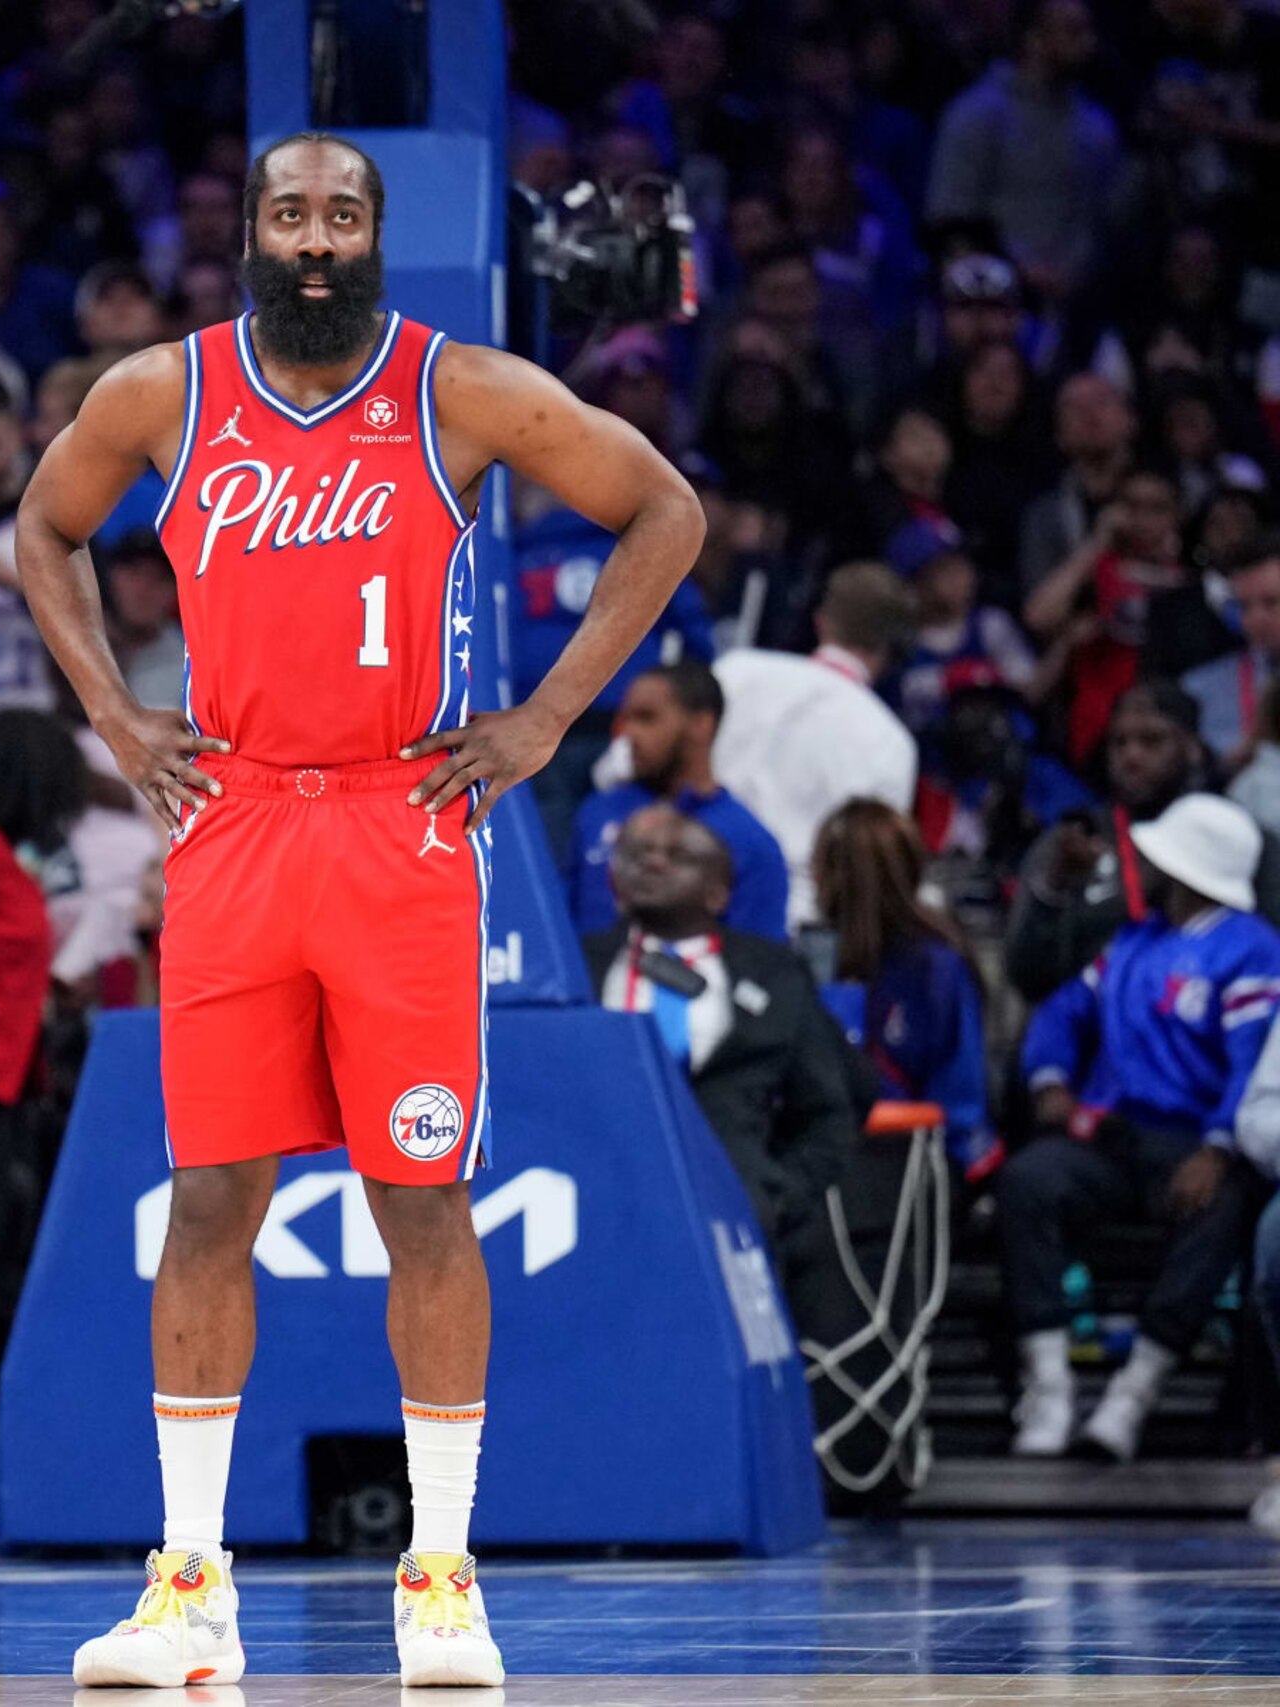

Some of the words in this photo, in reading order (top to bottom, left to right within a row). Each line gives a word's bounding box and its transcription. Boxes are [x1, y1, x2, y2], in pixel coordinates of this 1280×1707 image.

[349, 433, 412, 444] crypto.com
[195, 459, 397, 580] Phila
[358, 575, 389, 666] 1
[399, 1113, 456, 1141] 76ers
